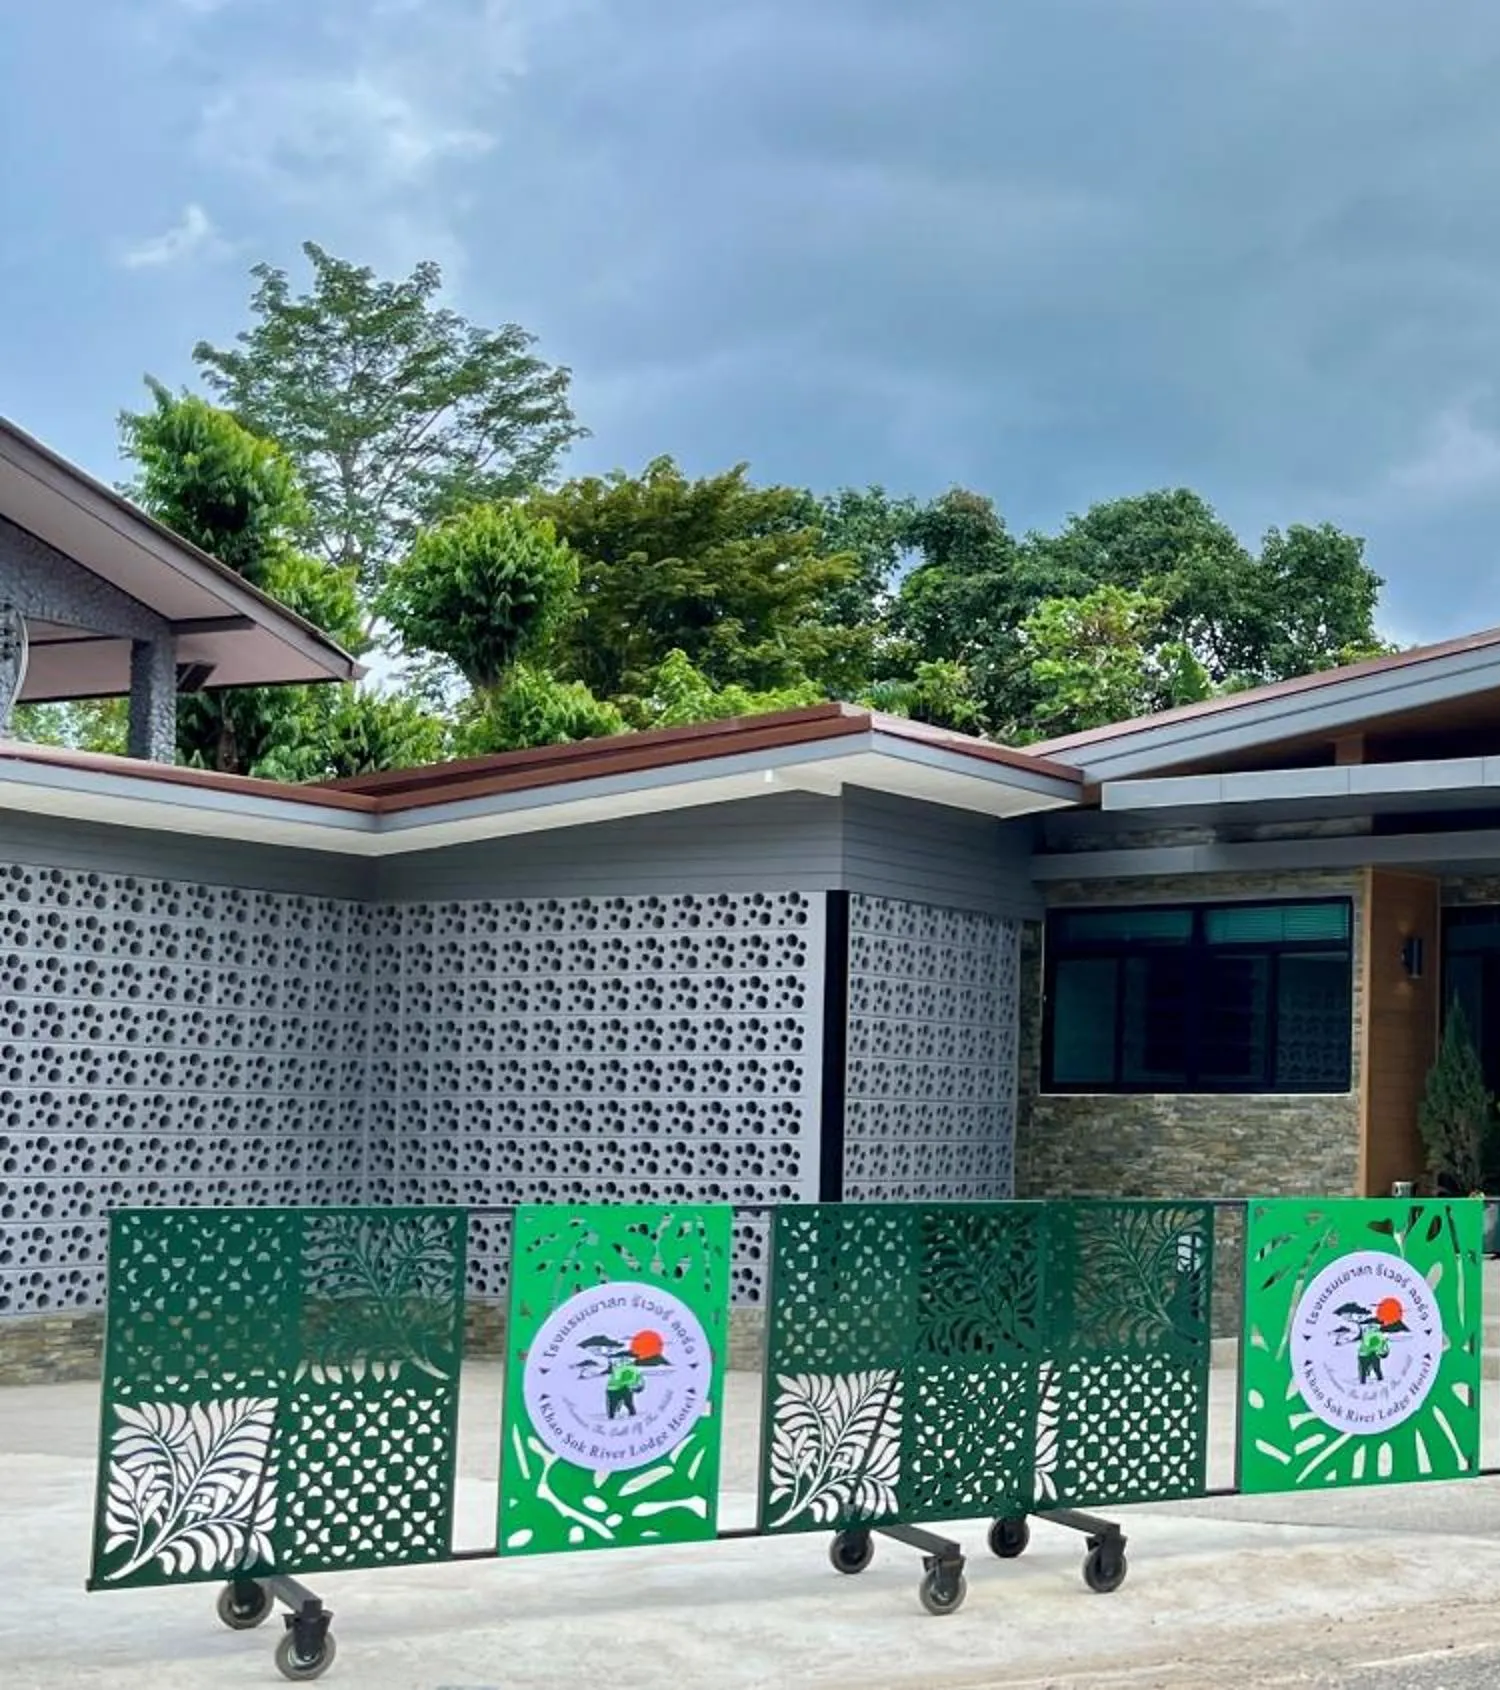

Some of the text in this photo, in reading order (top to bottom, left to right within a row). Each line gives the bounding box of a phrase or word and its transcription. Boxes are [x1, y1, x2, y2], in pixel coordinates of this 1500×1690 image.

[1323, 1396, 1344, 1417] Sok
[1345, 1408, 1376, 1423] River
[1377, 1395, 1411, 1420] Lodge
[1408, 1361, 1431, 1396] Hotel
[539, 1401, 564, 1436] Khao
[562, 1432, 587, 1454] Sok
[589, 1444, 627, 1460] River
[629, 1430, 670, 1457] Lodge
[667, 1396, 697, 1432] Hotel
